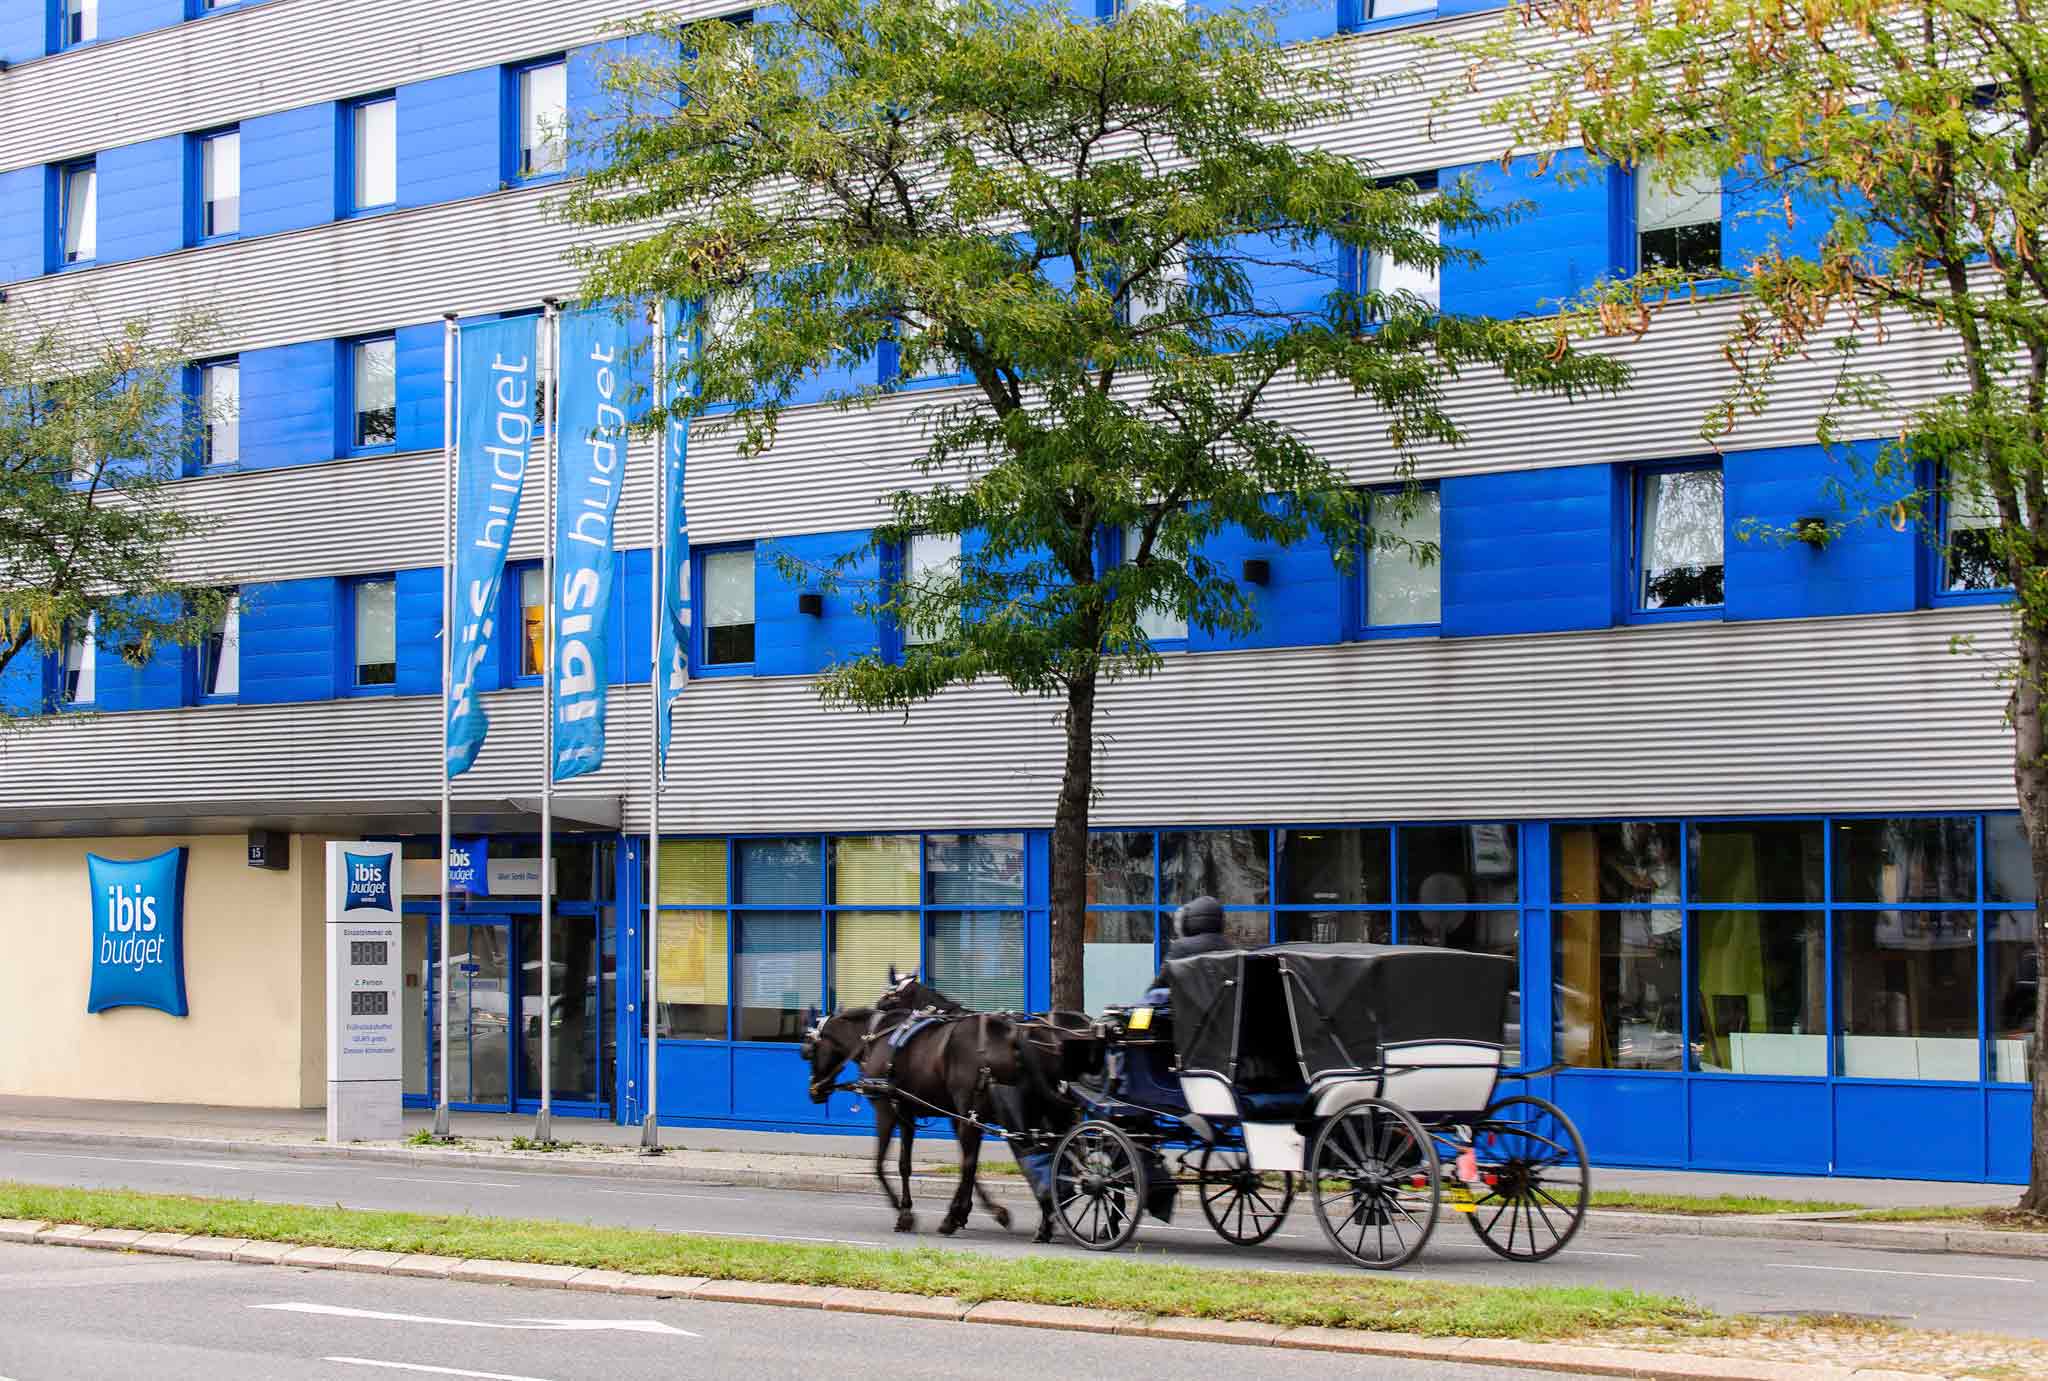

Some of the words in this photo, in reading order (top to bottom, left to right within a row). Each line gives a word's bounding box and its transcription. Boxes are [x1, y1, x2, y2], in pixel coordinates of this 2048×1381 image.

[567, 342, 625, 547] budget
[559, 568, 599, 723] ibis
[355, 864, 382, 881] ibis
[449, 849, 470, 867] ibis
[109, 884, 156, 932] ibis
[351, 881, 386, 897] budget
[100, 932, 165, 972] budget
